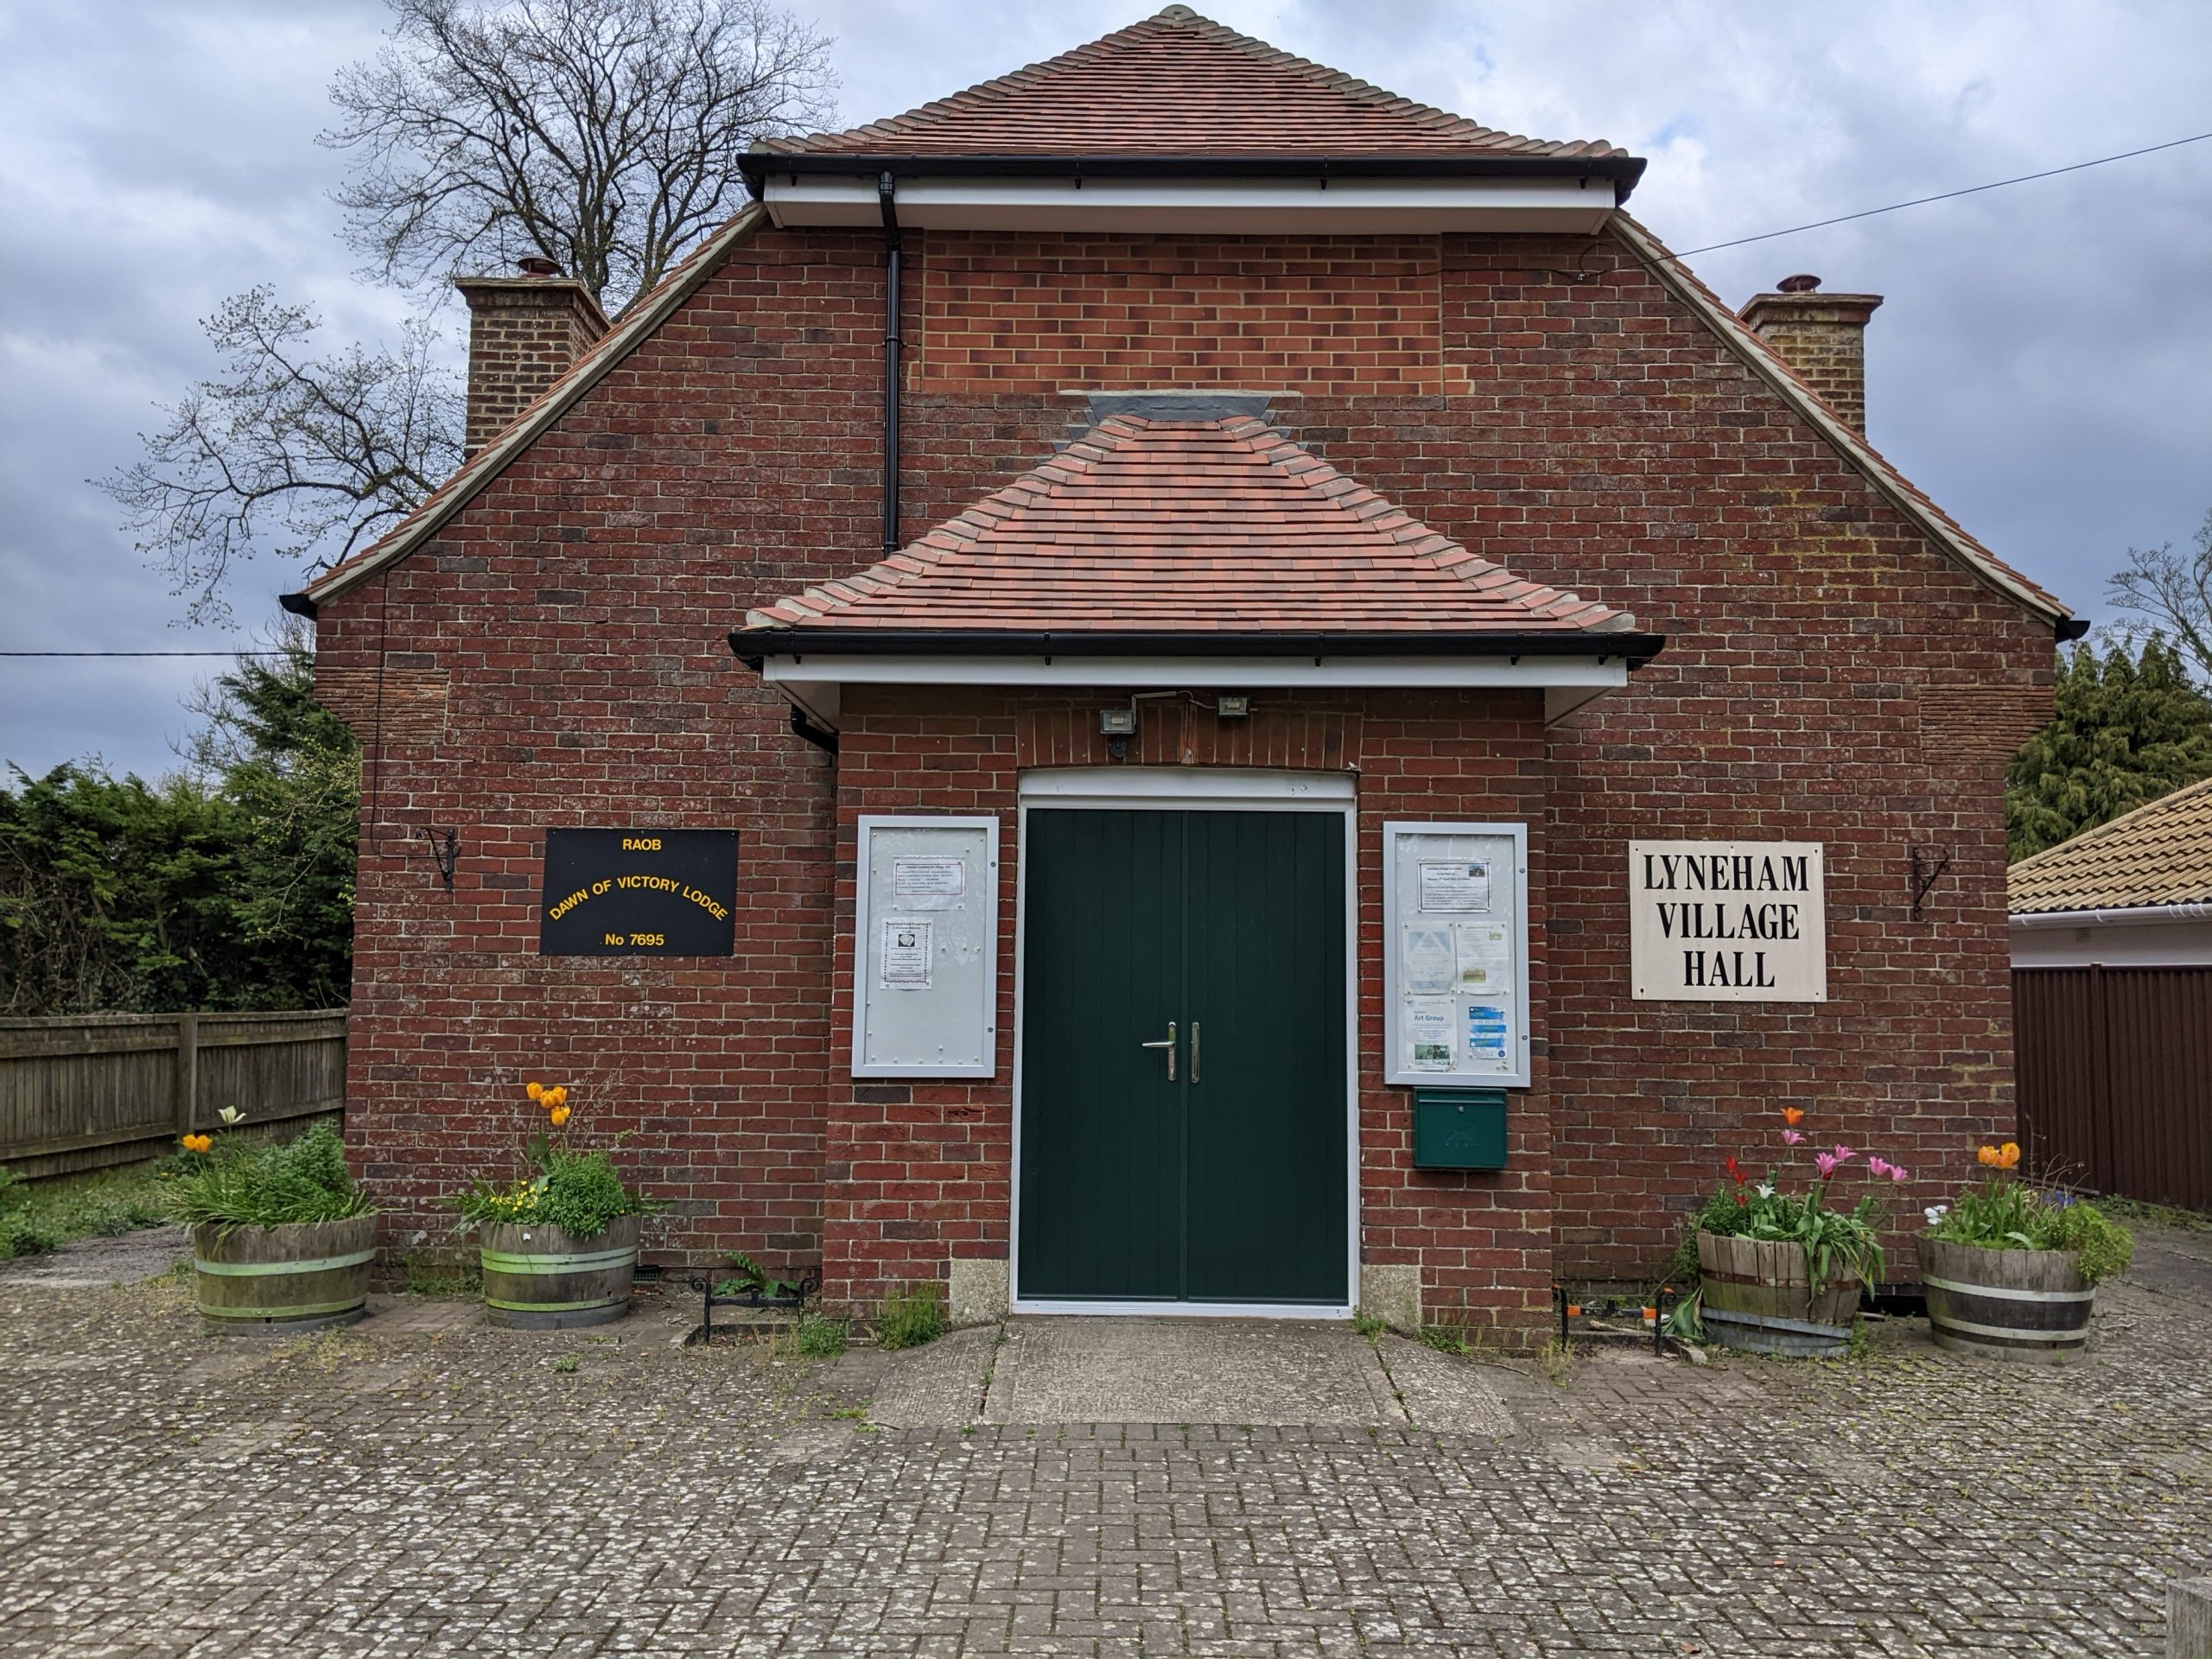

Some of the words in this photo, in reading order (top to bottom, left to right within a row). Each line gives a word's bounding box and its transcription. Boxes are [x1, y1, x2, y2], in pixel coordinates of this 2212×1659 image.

[622, 839, 662, 850] RAOB
[1643, 855, 1809, 892] LYNEHAM
[549, 888, 589, 920] DAWN
[592, 880, 612, 895] OF
[617, 875, 680, 893] VICTORY
[682, 886, 728, 921] LODGE
[1656, 902, 1800, 940] VILLAGE
[605, 934, 625, 946] No
[629, 934, 664, 946] 7695
[1683, 950, 1776, 988] HALL
